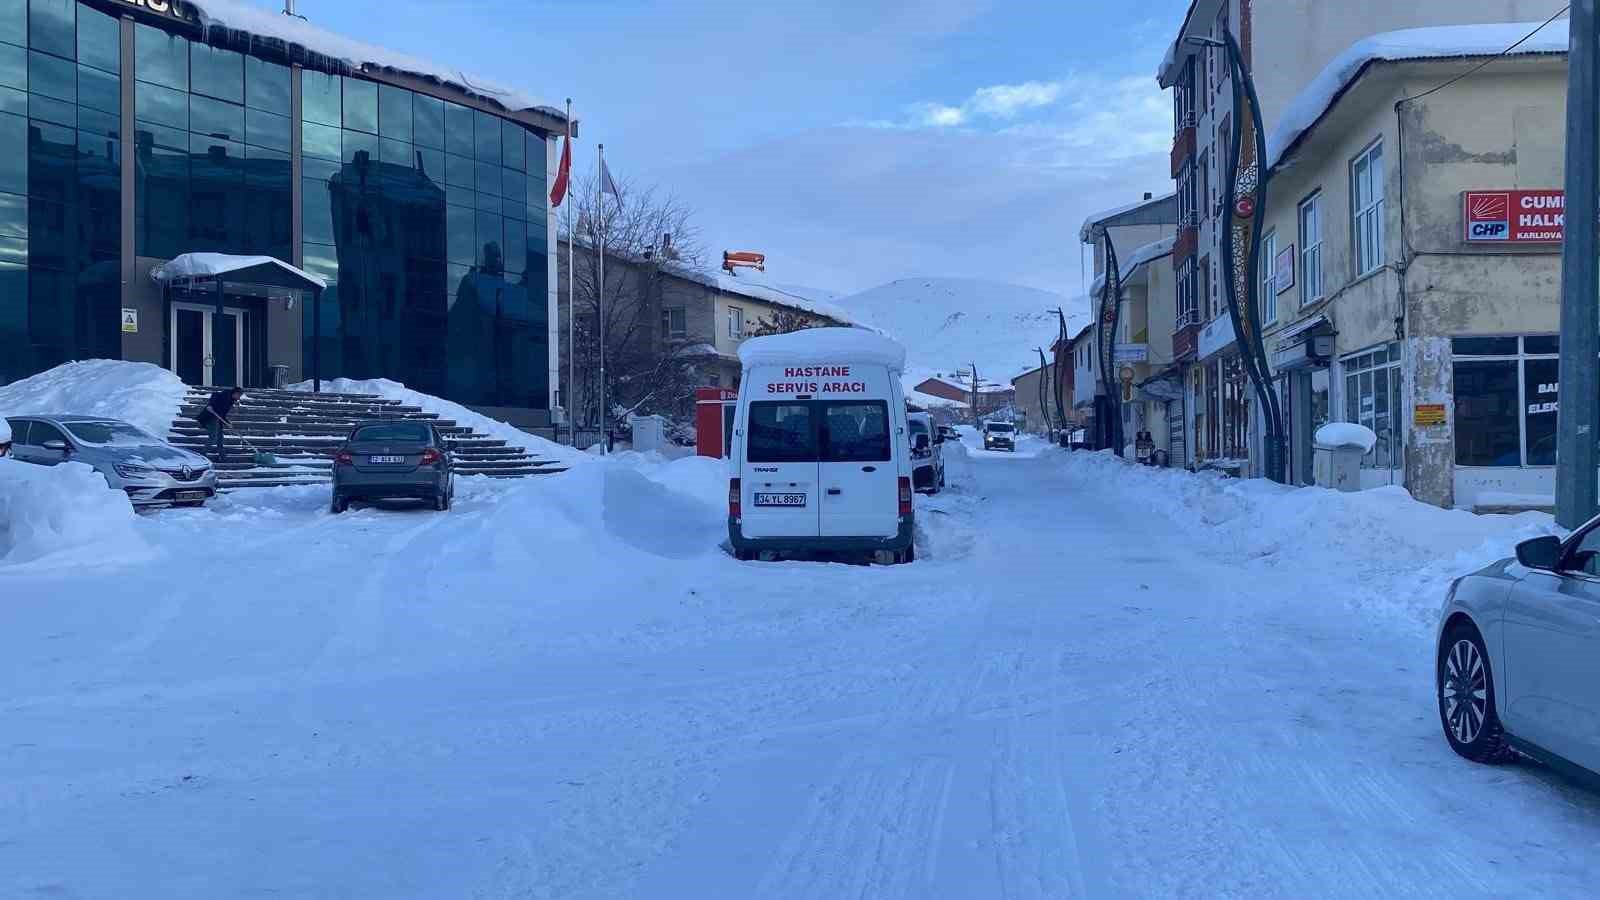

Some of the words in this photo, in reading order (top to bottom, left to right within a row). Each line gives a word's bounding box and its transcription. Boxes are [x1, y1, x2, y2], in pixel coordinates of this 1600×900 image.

[1472, 223, 1506, 236] CHP
[784, 366, 850, 377] HASTANE
[822, 382, 866, 393] ARACI
[760, 495, 770, 504] 34
[771, 495, 782, 504] YL
[784, 495, 804, 504] 8967
